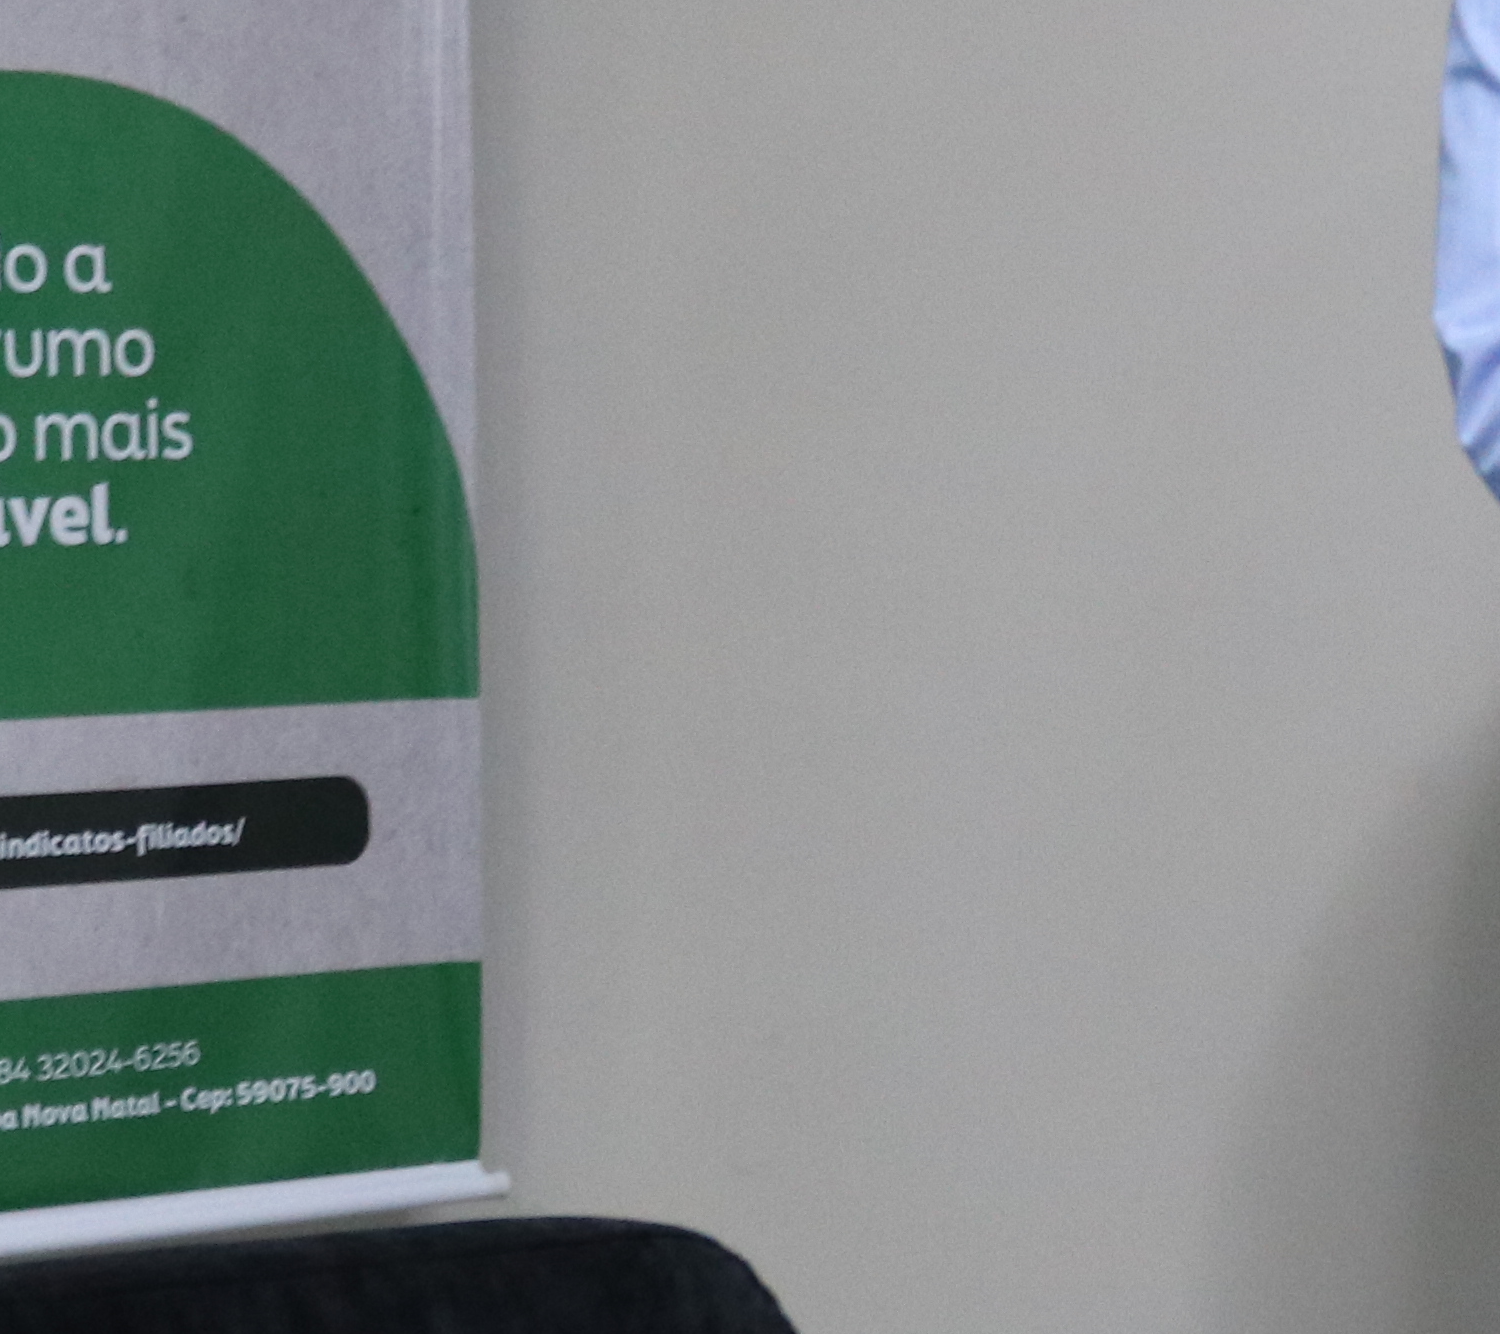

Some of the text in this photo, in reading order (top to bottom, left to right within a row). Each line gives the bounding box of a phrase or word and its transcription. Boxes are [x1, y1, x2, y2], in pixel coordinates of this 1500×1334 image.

[63, 242, 113, 294] a
[34, 396, 194, 463] mais
[35, 1038, 201, 1083] 32024-6256
[20, 1100, 90, 1130] Nova
[89, 1089, 162, 1123] Natal
[178, 1084, 234, 1116] Cep:
[234, 1067, 378, 1108] 59075-900
